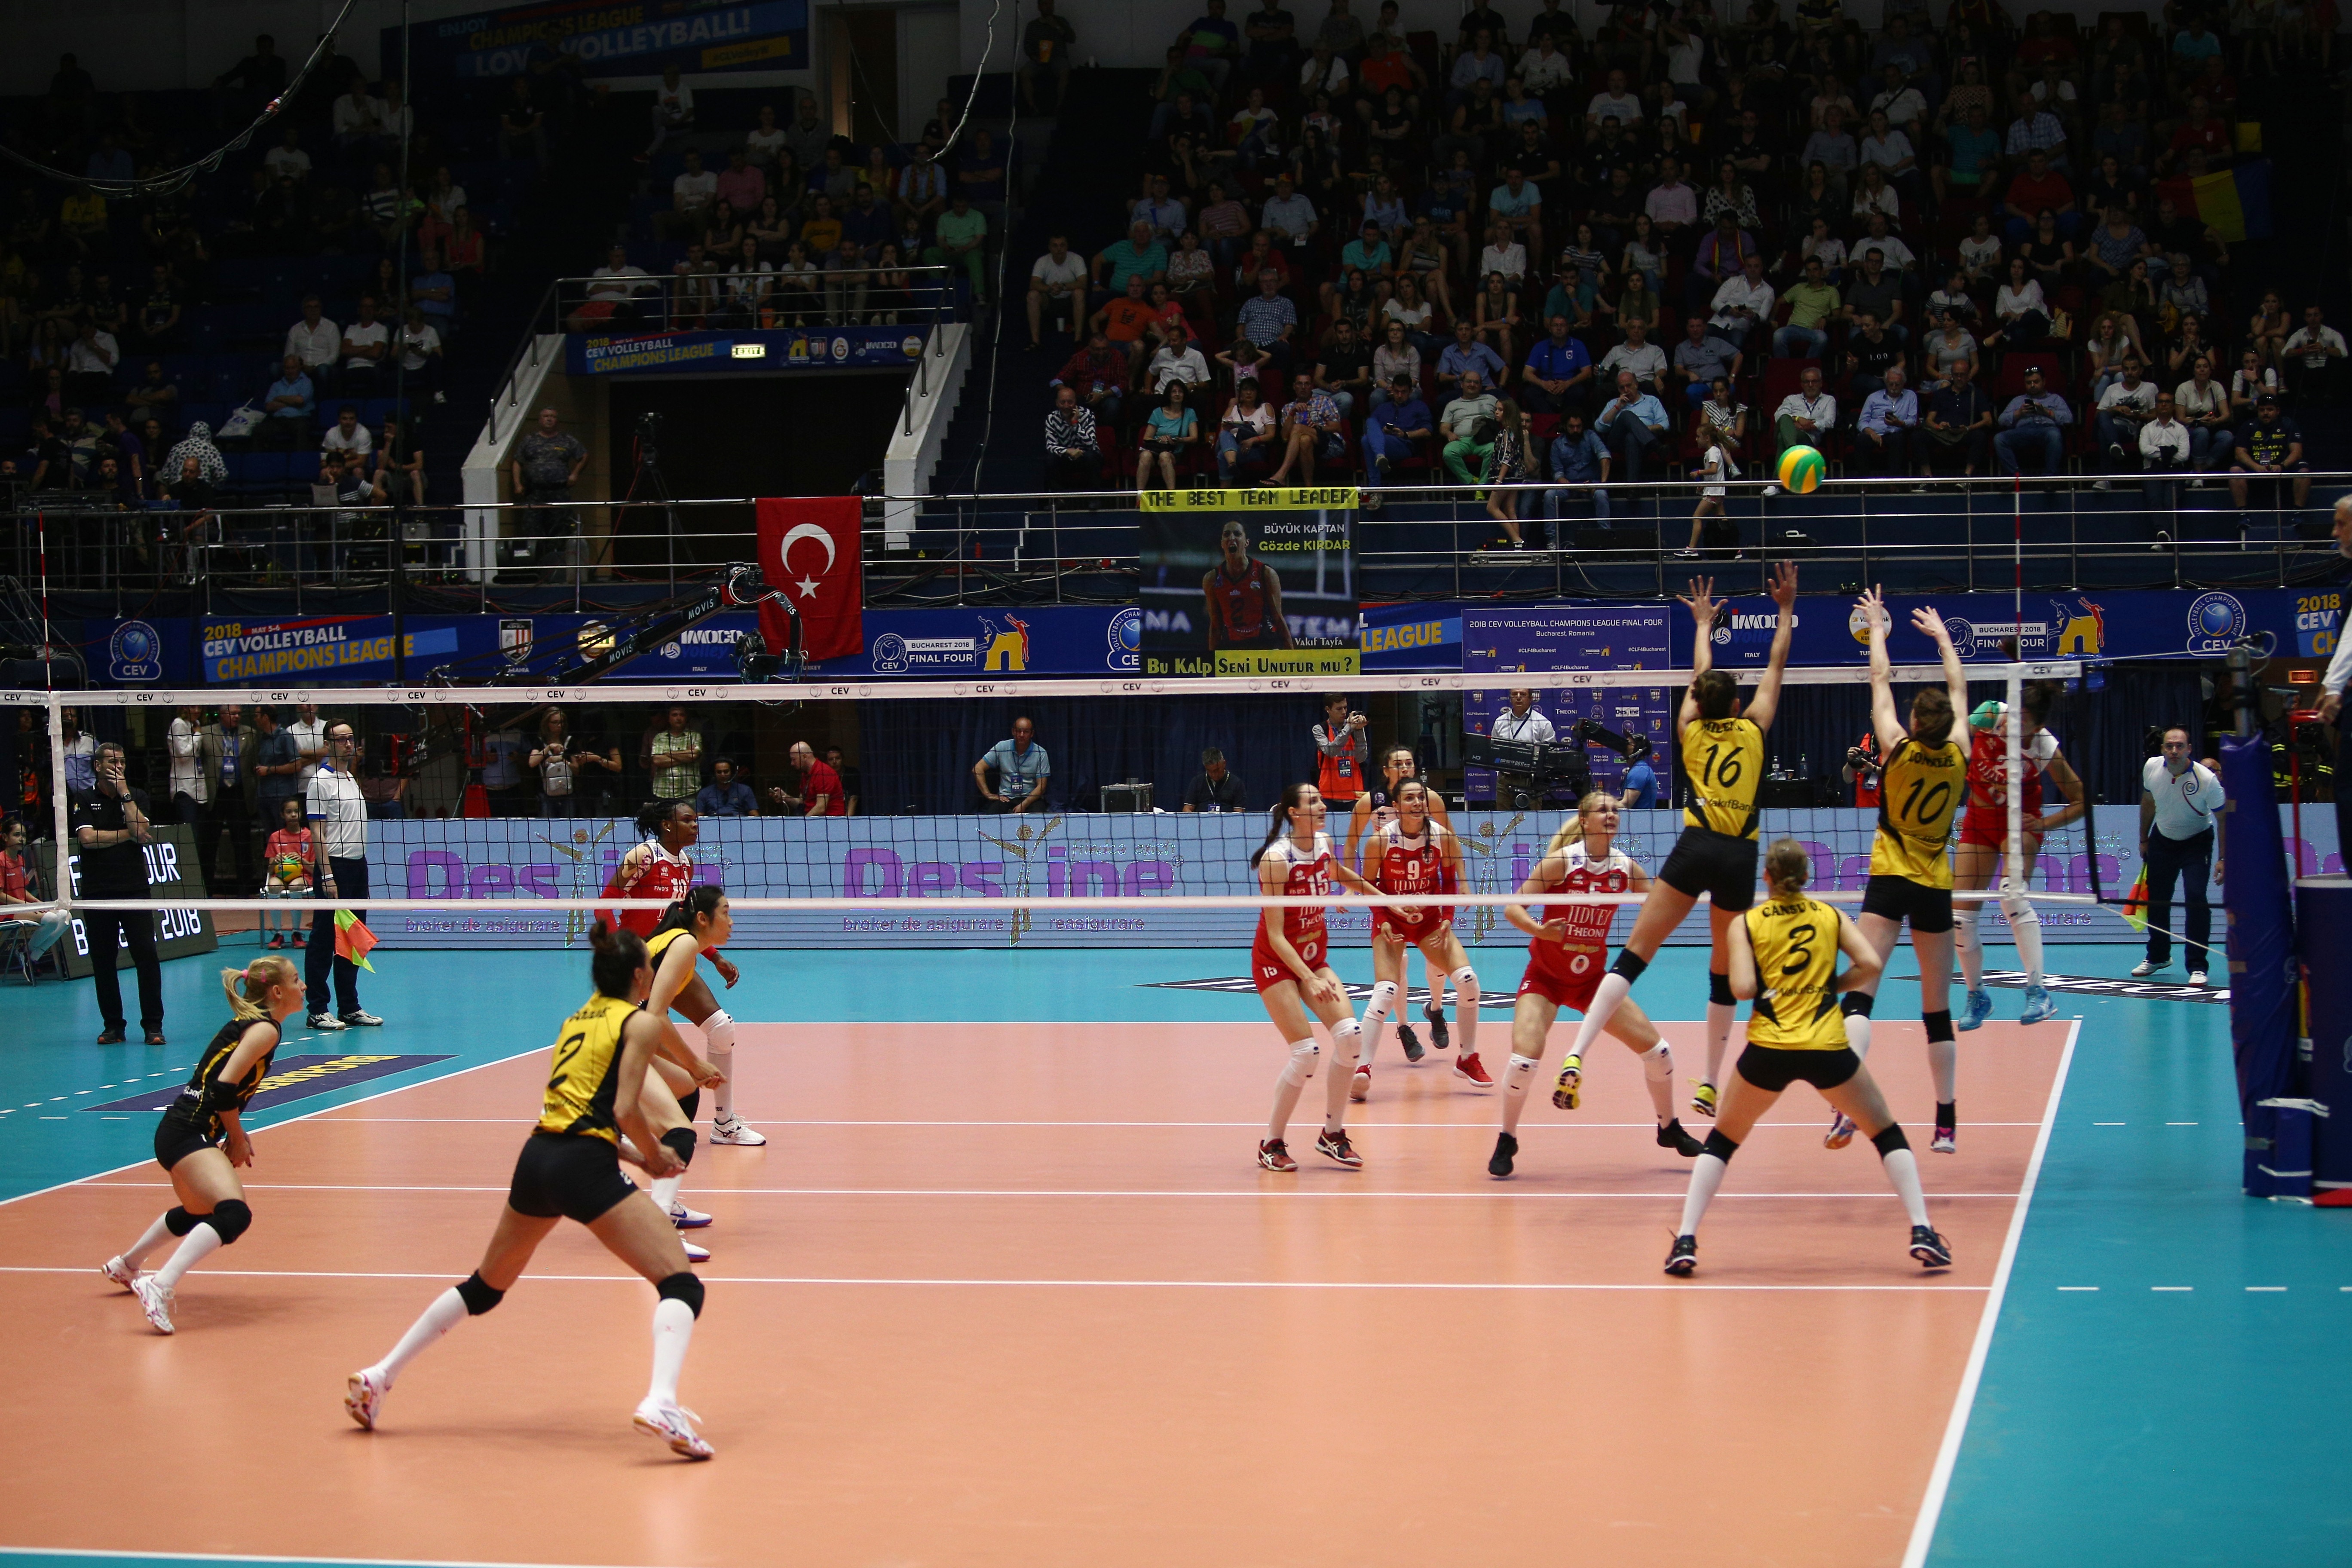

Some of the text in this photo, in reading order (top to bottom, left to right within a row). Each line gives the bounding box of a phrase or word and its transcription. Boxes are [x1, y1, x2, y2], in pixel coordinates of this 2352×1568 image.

[438, 17, 489, 37] ENJOY
[470, 6, 644, 50] CHAMPIS LEAGUE
[475, 47, 532, 77] LOV
[586, 337, 609, 348] 2018
[586, 338, 673, 358] CEV VOLLEYBALL
[594, 343, 714, 371] CHAMPIONS LEAGUE
[1147, 489, 1351, 506] THE BEST TEAM LEADER
[1264, 523, 1345, 534] BÜYÜK KAPTAN
[1259, 540, 1351, 552] Gözde KIRDAR
[688, 598, 714, 620] MOVIS
[2297, 594, 2341, 613] 2018
[2192, 601, 2205, 637] VOLLEYBALL
[2205, 596, 2238, 612] CHAMPIONS
[2297, 611, 2334, 630] CEV
[204, 623, 242, 641] 2018
[251, 626, 266, 634] MAY
[204, 626, 347, 657] CEV VOLLEYBALL
[1111, 616, 1124, 652] VOLLEYBALL
[1361, 622, 1442, 653] LEAGUE
[1977, 638, 2045, 647] FINA OUR
[2202, 640, 2232, 650] CEV
[217, 645, 335, 679] CHAMPIONS
[609, 645, 633, 663] MOVIS
[909, 654, 973, 662] FINAL FOUR
[1121, 655, 1139, 665] CE
[122, 665, 148, 676] CEV
[1421, 678, 1440, 686] CEV
[1704, 743, 1744, 788] 16
[1901, 778, 1951, 825] 10
[142, 842, 182, 885] OUR
[1407, 860, 1420, 880] 9
[1307, 870, 1330, 896] 15
[1762, 902, 1806, 917] CANSU
[406, 916, 560, 934] broker de asigurare
[843, 915, 1145, 933] broker de asigurare reasigurare
[1567, 924, 1605, 937] THEONI
[1782, 924, 1816, 975] 3
[1262, 966, 1278, 978] 15
[1521, 980, 1531, 991] 5
[548, 1032, 585, 1090] 2
